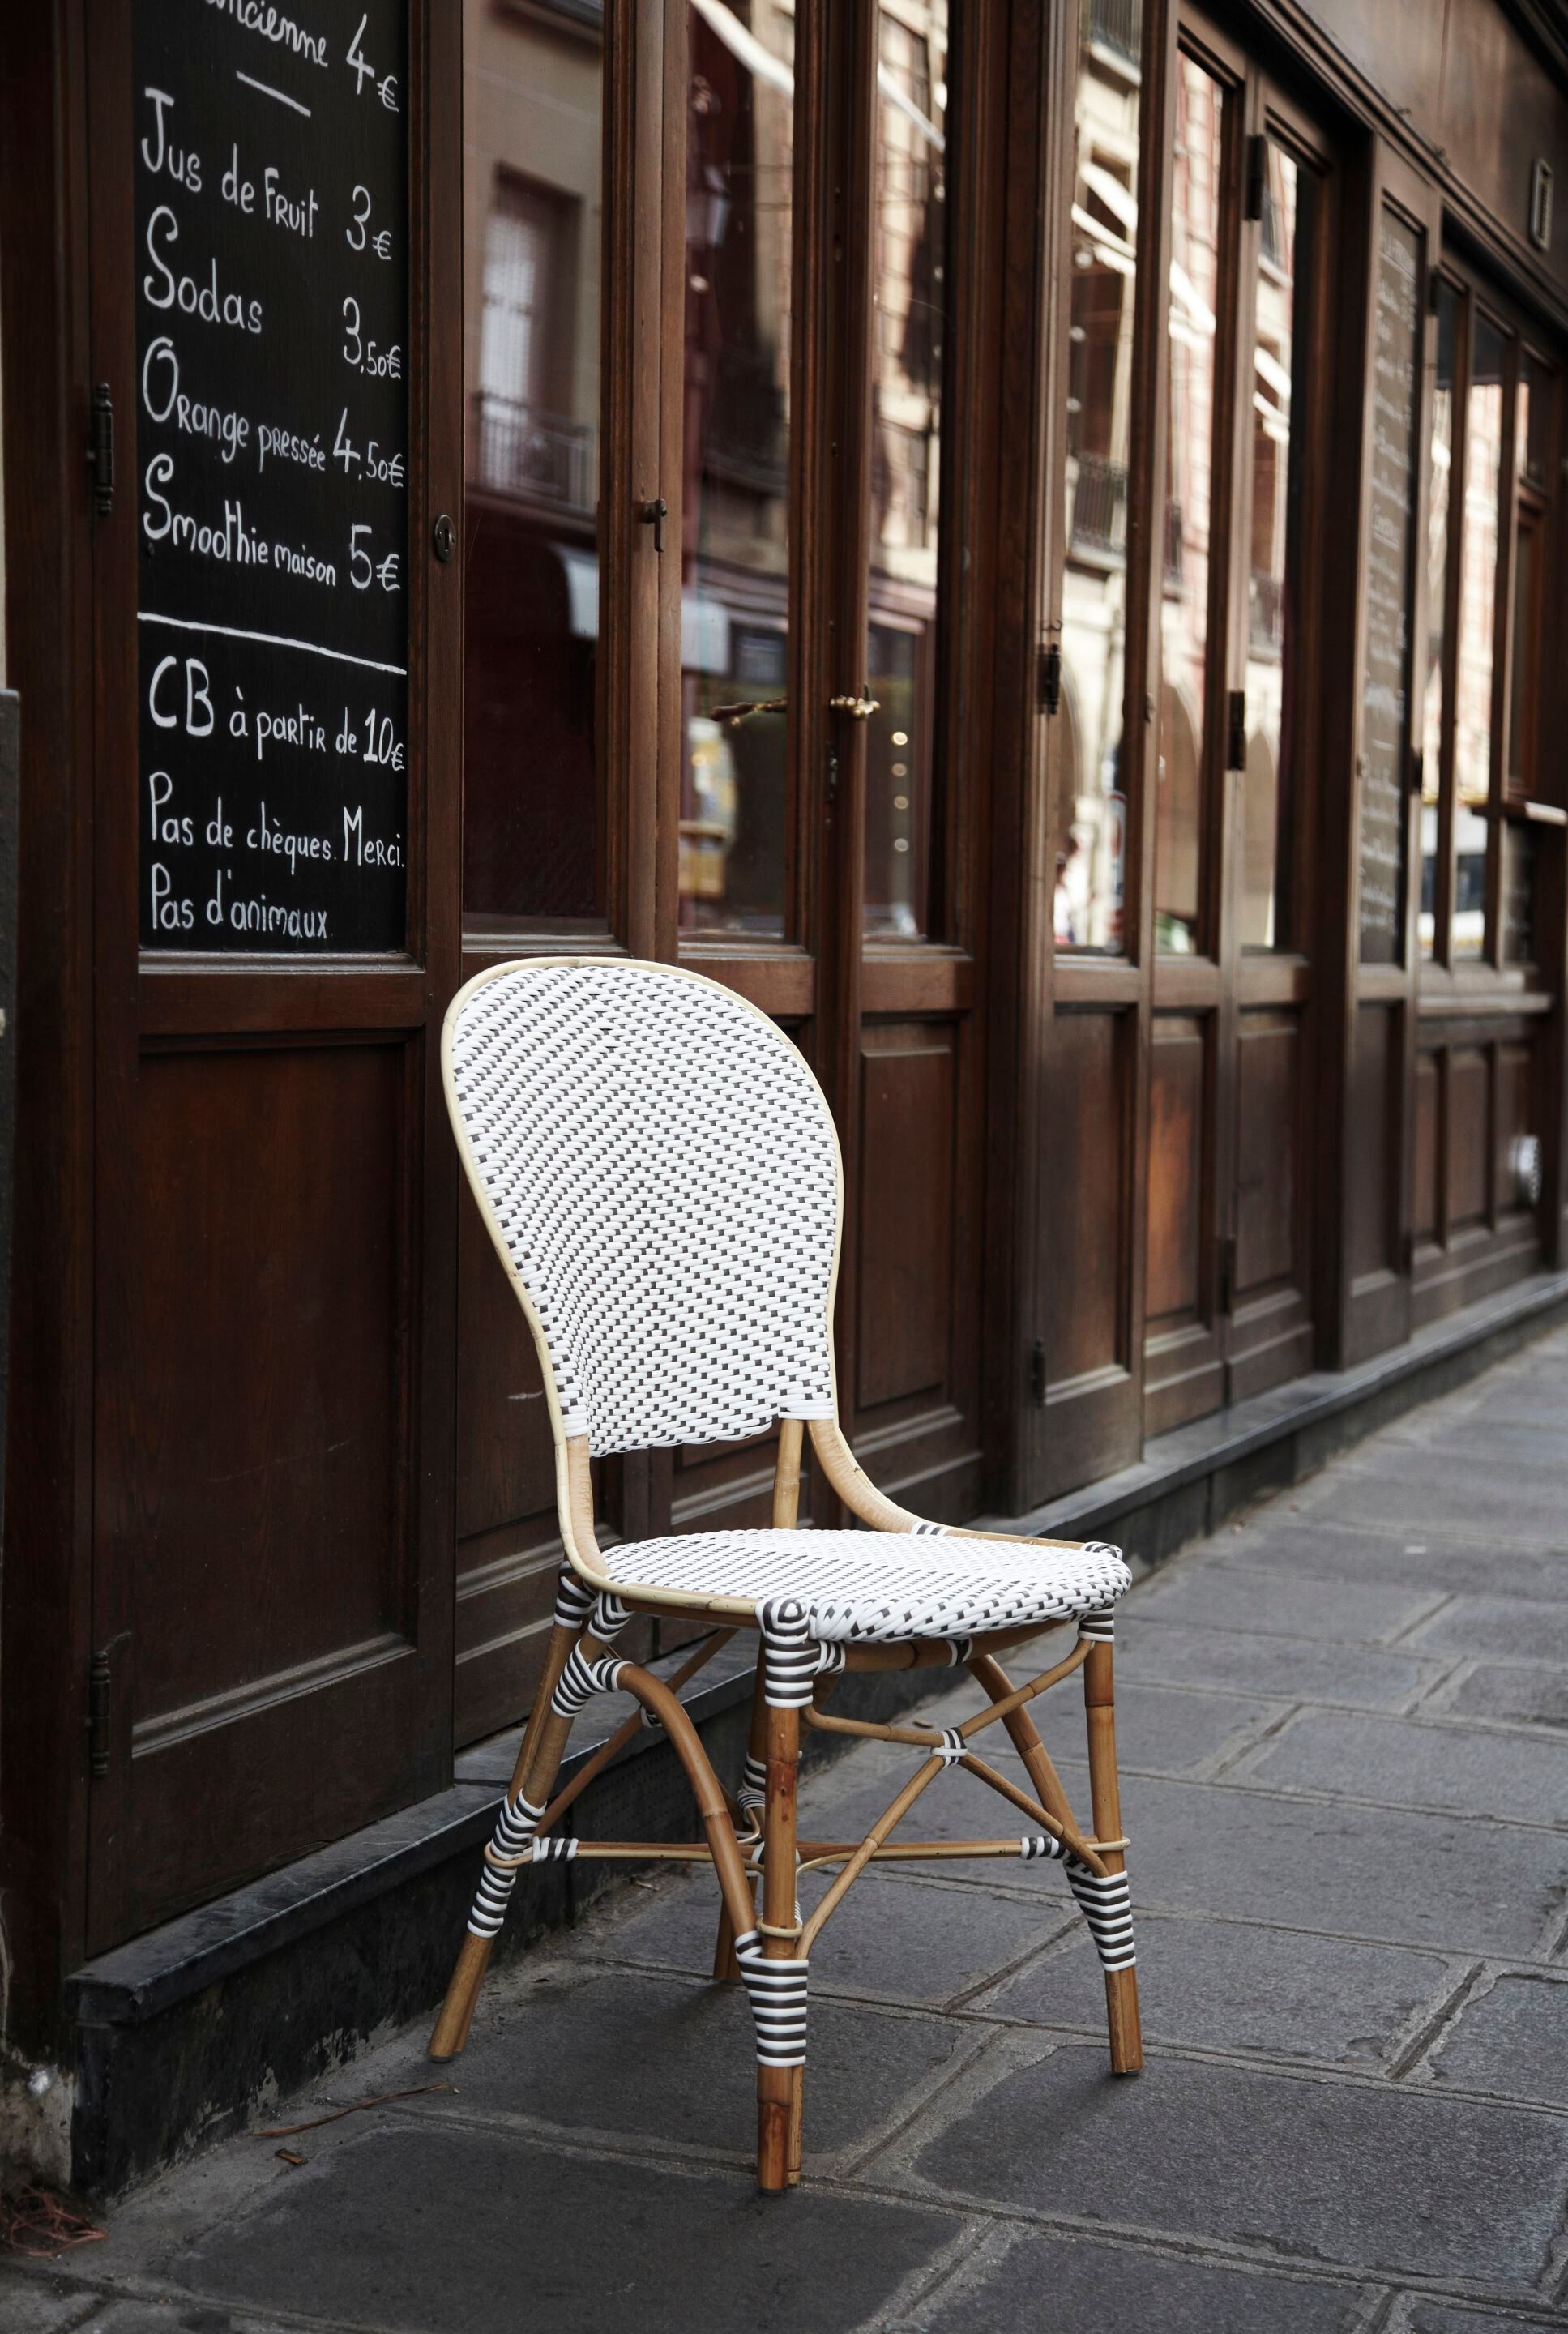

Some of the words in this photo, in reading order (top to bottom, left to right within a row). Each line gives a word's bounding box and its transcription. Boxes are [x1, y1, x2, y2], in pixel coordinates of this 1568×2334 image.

[141, 87, 203, 193] Jus
[221, 143, 255, 214] de
[346, 185, 393, 260] 3€
[143, 205, 263, 334] Sodas
[143, 452, 270, 565] Smoothie
[273, 543, 336, 587] maison
[348, 523, 401, 592] 5€
[148, 655, 215, 737] CB
[229, 686, 249, 737] à
[335, 706, 357, 754] de
[362, 707, 405, 772] 10€
[148, 771, 194, 846] Pas
[206, 796, 234, 849] de
[151, 861, 194, 930] Pas
